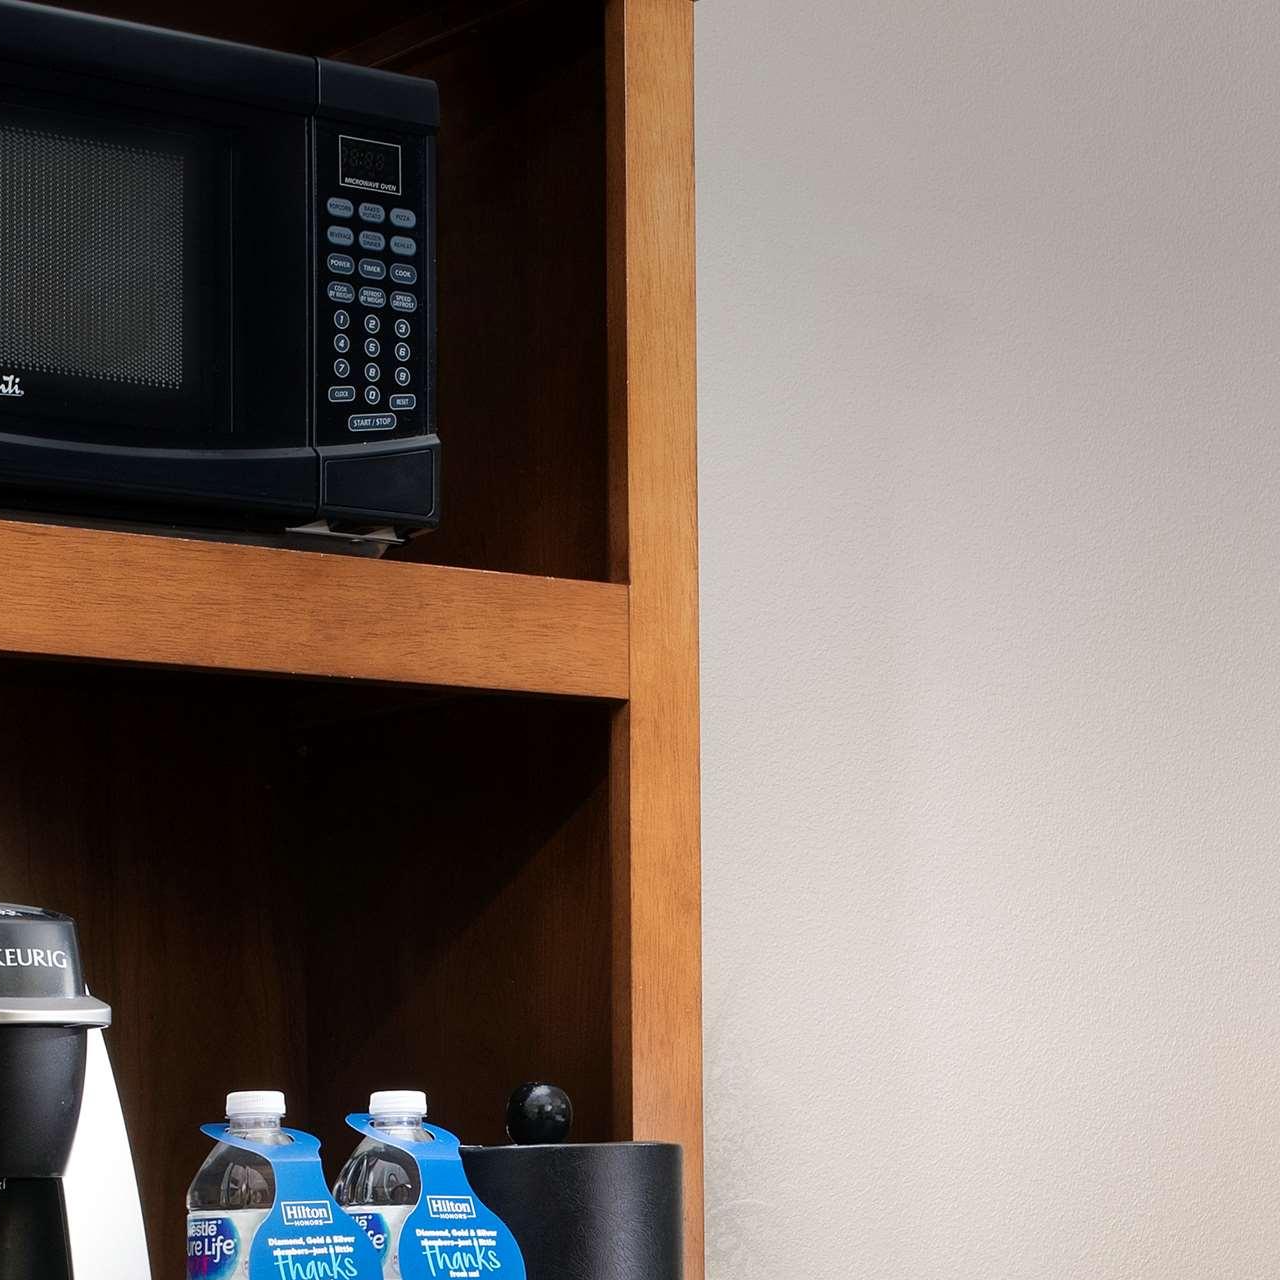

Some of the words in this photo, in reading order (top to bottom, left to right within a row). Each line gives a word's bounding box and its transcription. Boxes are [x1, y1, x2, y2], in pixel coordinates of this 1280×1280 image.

[345, 177, 380, 188] MICROWAVE
[380, 183, 396, 192] OVEN
[395, 214, 410, 222] PIZZA
[330, 259, 351, 268] POWER
[363, 264, 381, 273] TIMER
[394, 270, 412, 278] COOK
[368, 320, 376, 329] 2
[399, 324, 406, 333] 3
[338, 339, 345, 348] 4
[368, 343, 376, 352] 5
[399, 347, 406, 356] 6
[338, 364, 345, 373] 7
[368, 368, 376, 377] 8
[399, 372, 406, 381] 9
[334, 390, 349, 398] CLOCK
[368, 390, 376, 400] 0
[353, 419, 371, 428] START
[376, 418, 392, 426] STOP
[431, 1200, 471, 1213] Hilton
[286, 1206, 328, 1219] Hilton
[416, 1229, 451, 1237] Diamond,
[451, 1229, 468, 1237] Gold
[268, 1238, 305, 1246] Diamond,
[307, 1236, 324, 1244] Gold
[333, 1235, 355, 1243] Silver
[186, 1240, 202, 1256] ure
[204, 1236, 235, 1263] Life
[449, 1270, 467, 1278] from
